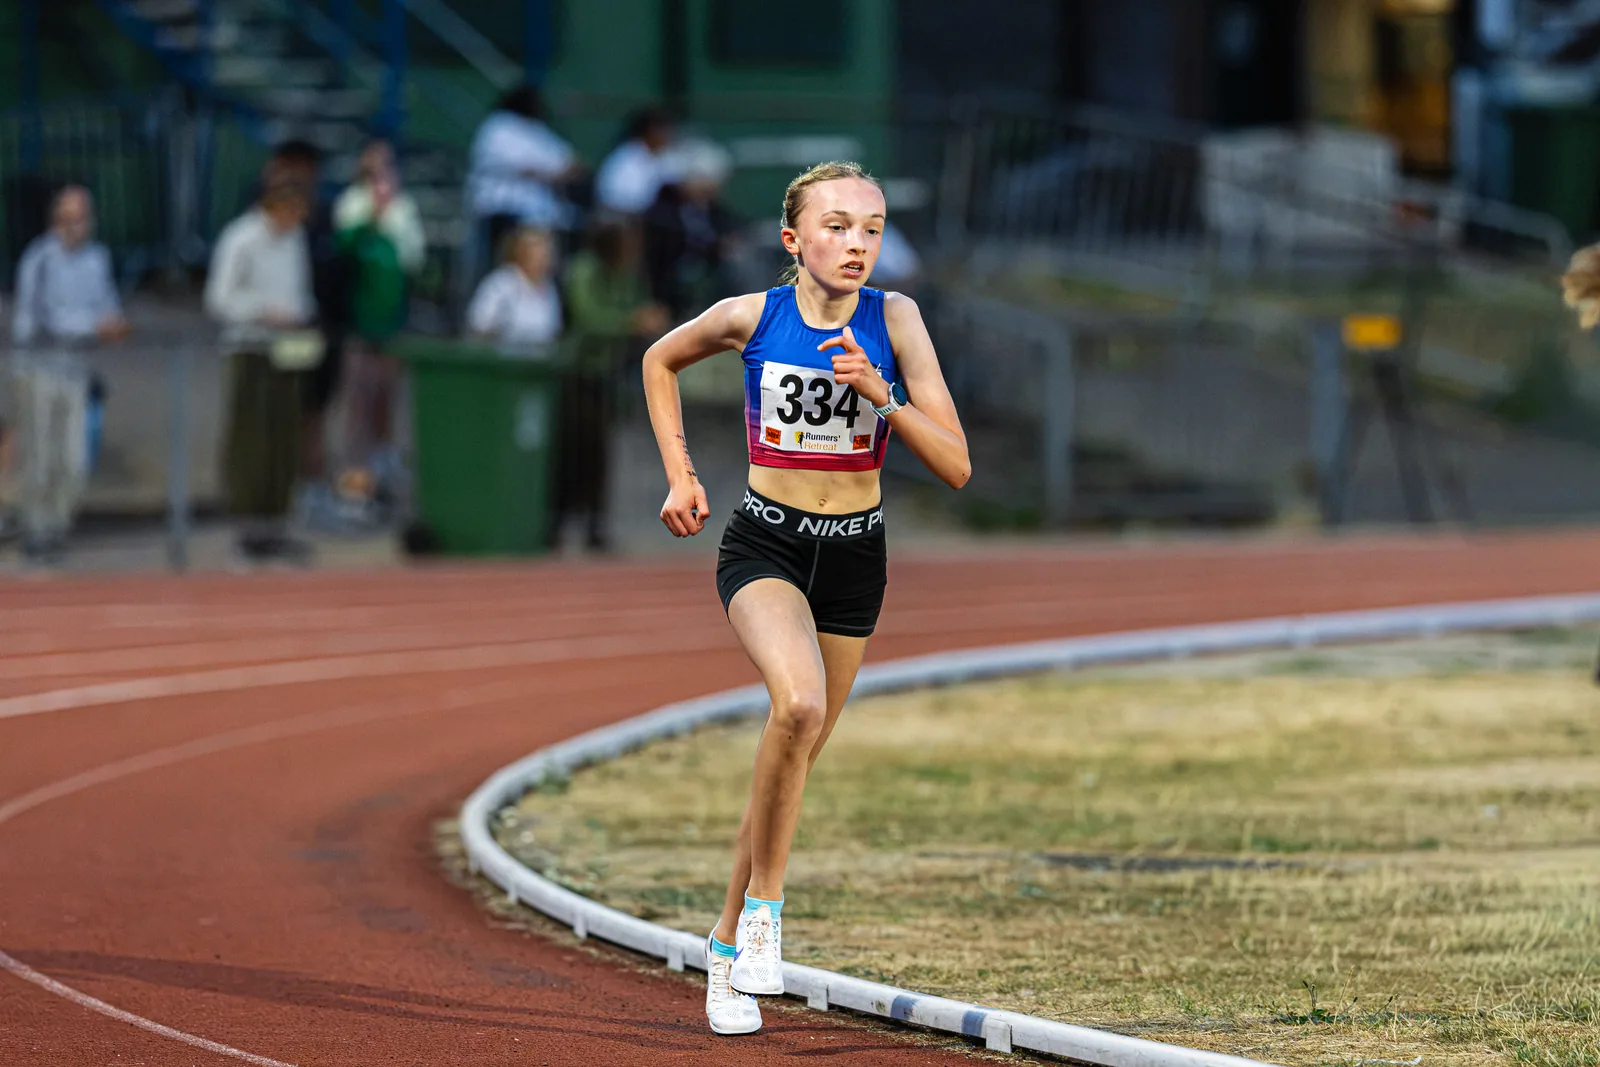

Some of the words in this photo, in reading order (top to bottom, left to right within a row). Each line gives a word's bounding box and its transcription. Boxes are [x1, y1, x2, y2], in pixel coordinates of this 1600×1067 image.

[776, 374, 861, 428] 334
[804, 441, 837, 451] Retreat
[805, 432, 841, 442] Runners'
[743, 489, 785, 524] PRO
[797, 517, 864, 537] NIKE
